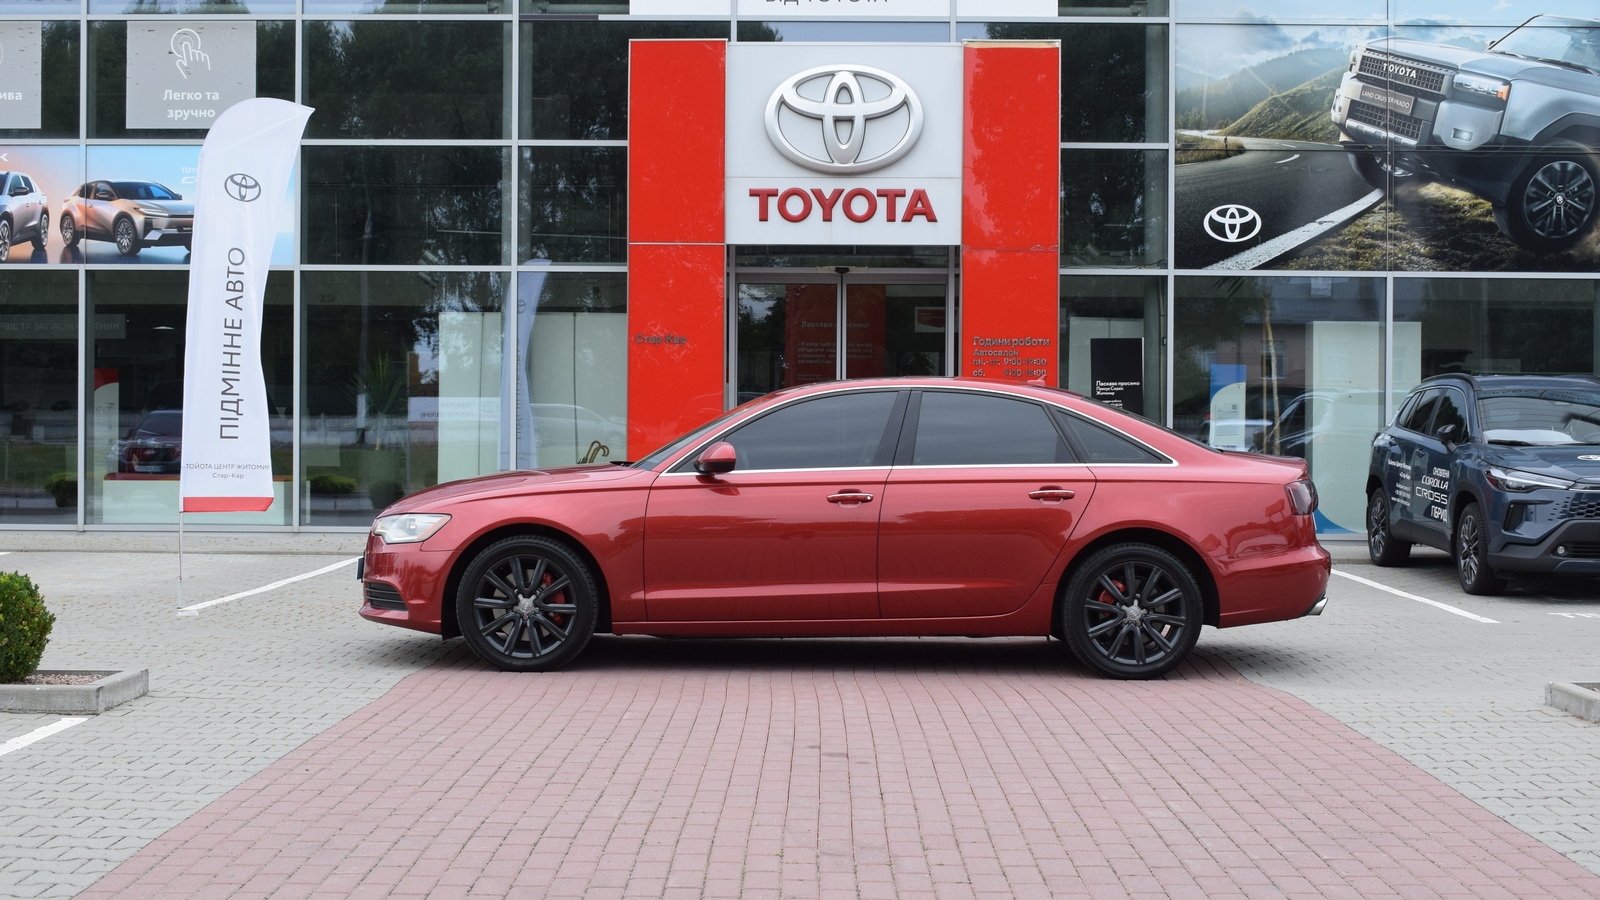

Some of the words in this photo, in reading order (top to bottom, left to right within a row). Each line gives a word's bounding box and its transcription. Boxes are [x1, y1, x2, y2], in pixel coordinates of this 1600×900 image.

[1383, 63, 1416, 79] TOYOTA
[163, 89, 202, 101] Легко
[204, 91, 220, 101] та
[1361, 90, 1375, 99] LAND
[1393, 98, 1410, 109] PRADO
[166, 108, 216, 120] зручно
[749, 187, 938, 223] TOYOTA
[224, 247, 246, 311] АВТО
[635, 333, 688, 346] Стар-Кар
[973, 336, 1010, 347] Години
[1011, 336, 1050, 348] роботи
[973, 348, 1019, 357] Автосалон
[219, 317, 243, 440] ПІДМІННЕ
[186, 462, 213, 470] ТОЙОТА
[1421, 475, 1449, 490] COROLLA
[1416, 486, 1448, 504] CROSS
